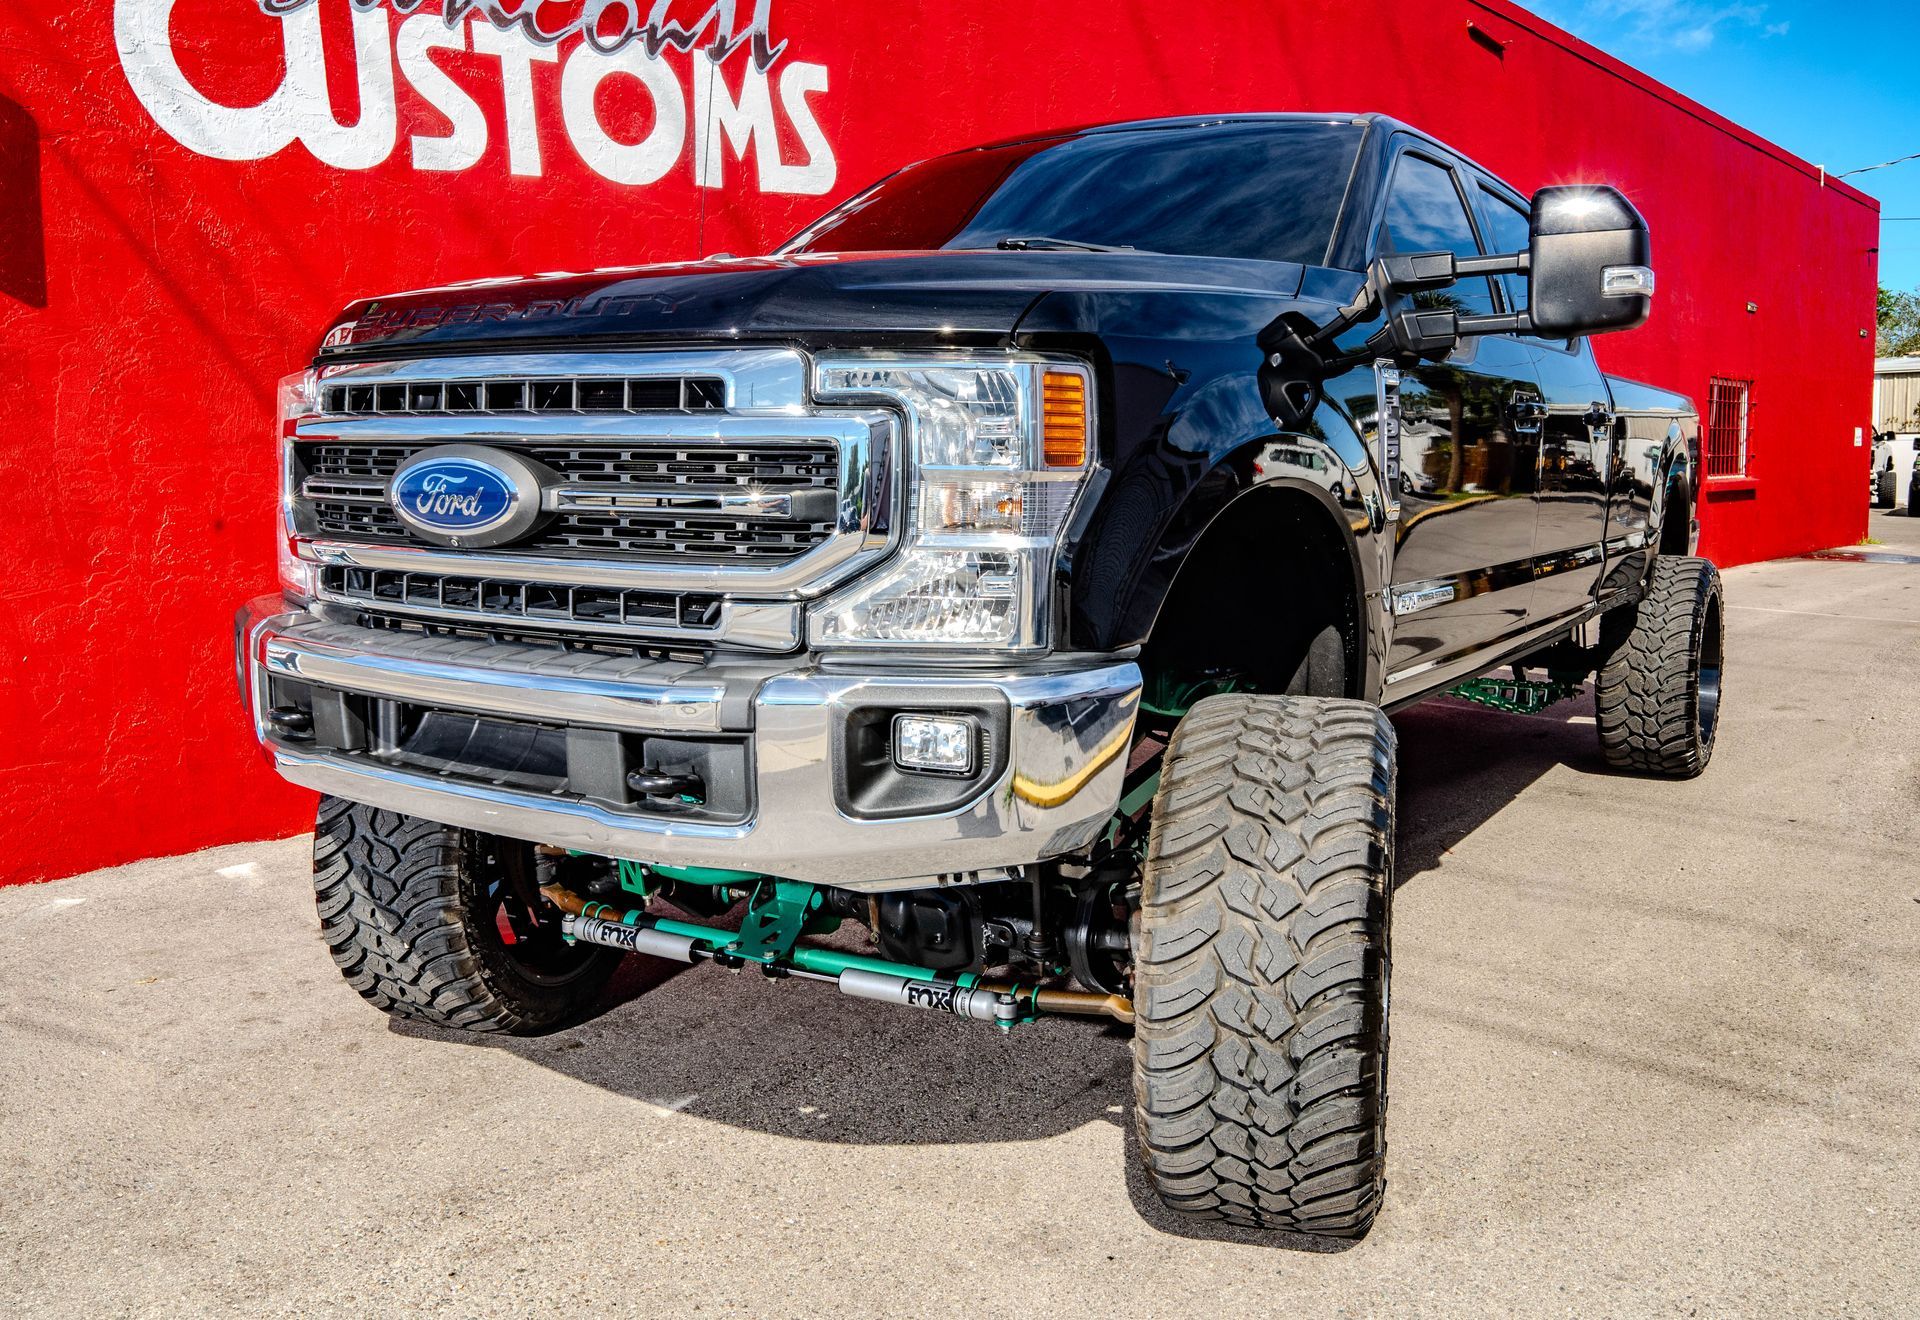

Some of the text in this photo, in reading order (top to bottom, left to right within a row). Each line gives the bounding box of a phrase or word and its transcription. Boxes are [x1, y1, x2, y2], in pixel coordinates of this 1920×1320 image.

[113, 0, 838, 197] CUSTOMS
[352, 292, 698, 331] SUPER DUTY
[416, 473, 485, 517] Ford
[600, 924, 635, 948] FOX
[907, 986, 950, 1011] FOX
